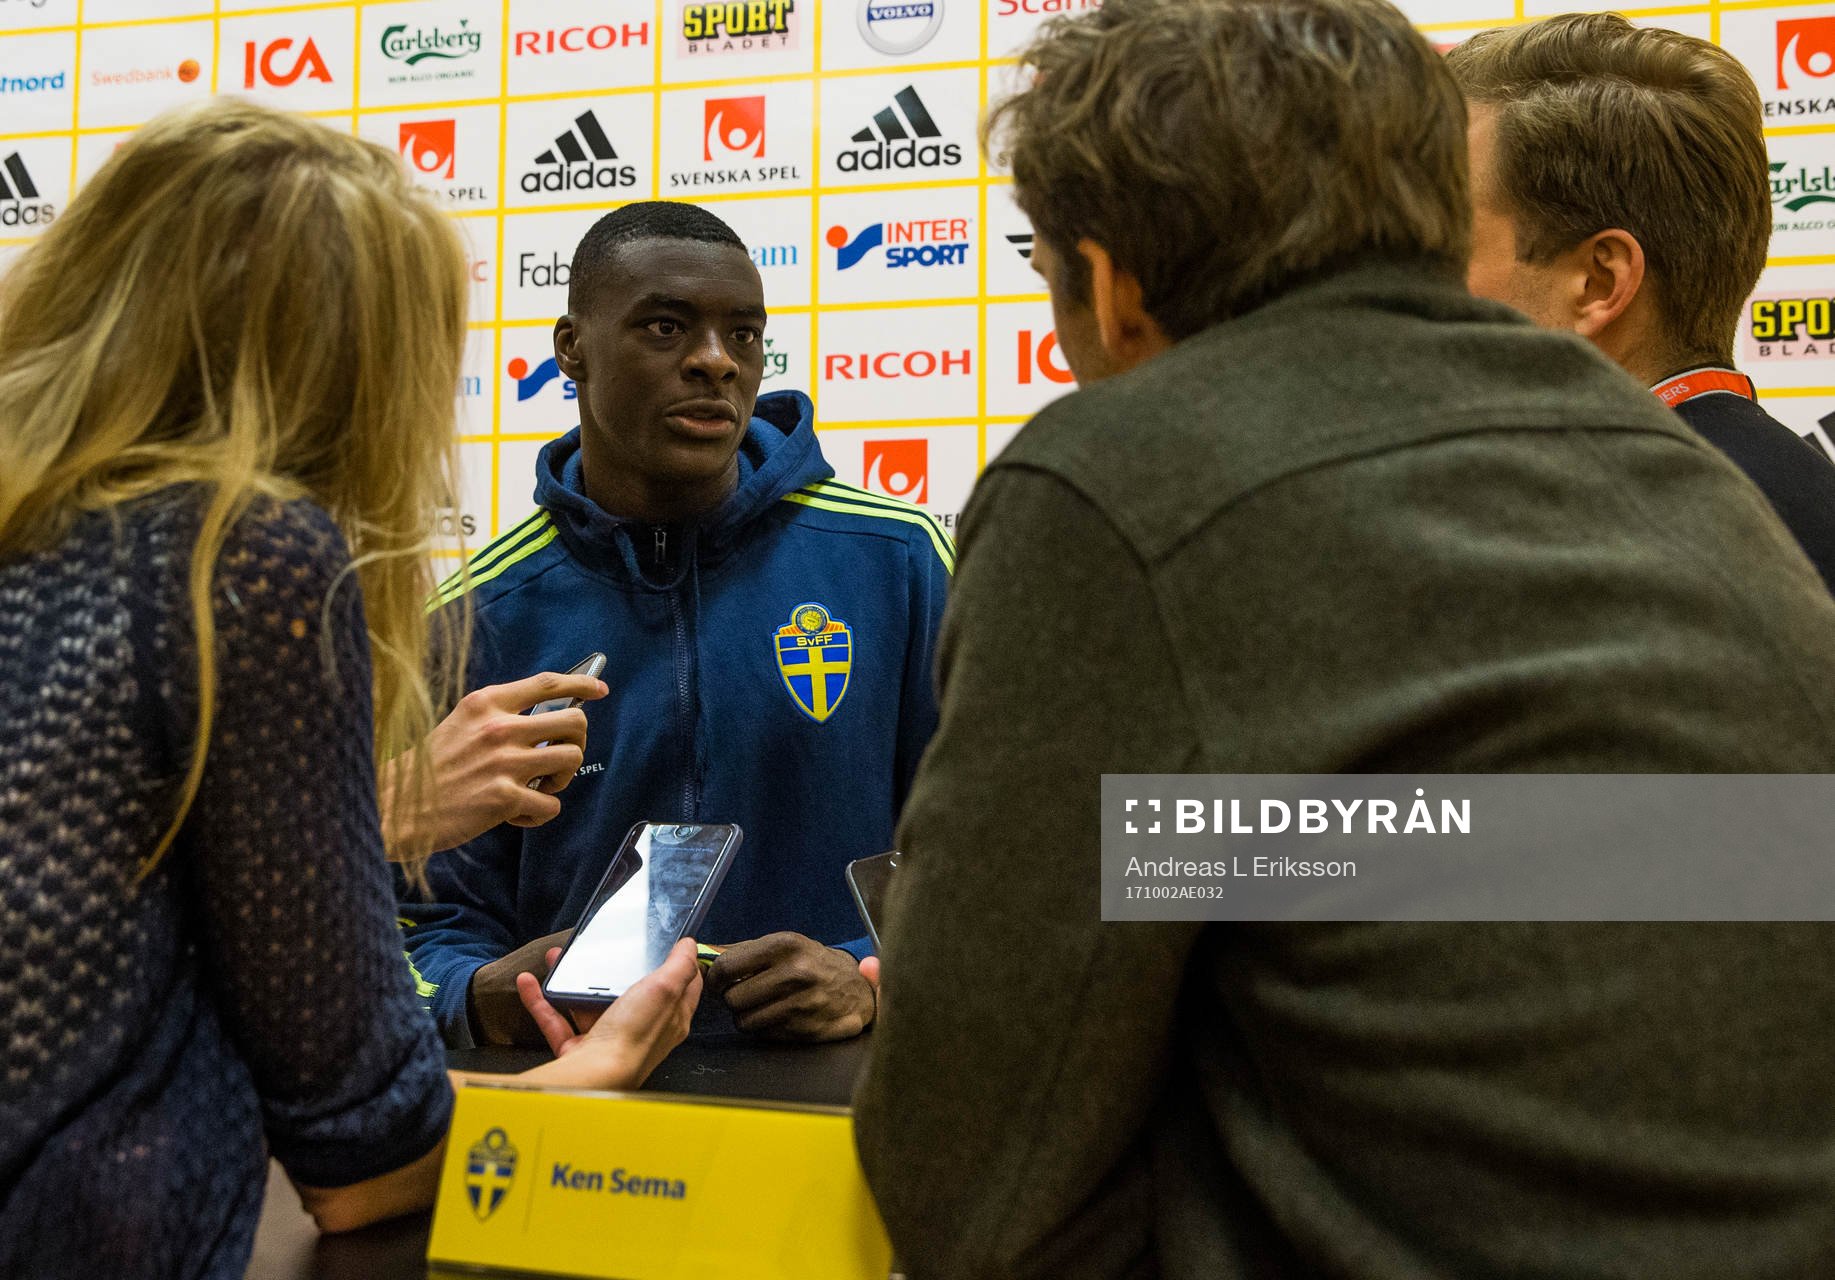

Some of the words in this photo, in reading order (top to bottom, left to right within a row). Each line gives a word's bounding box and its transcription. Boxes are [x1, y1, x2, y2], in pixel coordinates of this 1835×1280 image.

[683, 0, 794, 41] SPORT
[869, 5, 933, 19] VOLVO
[381, 22, 481, 61] Carlsberg
[515, 22, 649, 56] RICOH
[688, 36, 788, 53] BLADET
[244, 36, 333, 90] ICA
[91, 69, 173, 86] Swedbank
[836, 139, 963, 173] adidas
[520, 161, 637, 193] adidas
[670, 168, 751, 187] SVENSKA
[757, 165, 801, 182] SPEL
[448, 187, 487, 201] SPEL
[886, 218, 968, 245] INTER
[886, 242, 970, 269] SPORT
[825, 349, 972, 381] RICOH
[796, 634, 833, 647] SvFF
[579, 762, 606, 776] SPEL
[550, 1162, 603, 1192] Ken
[609, 1168, 687, 1200] Sema
